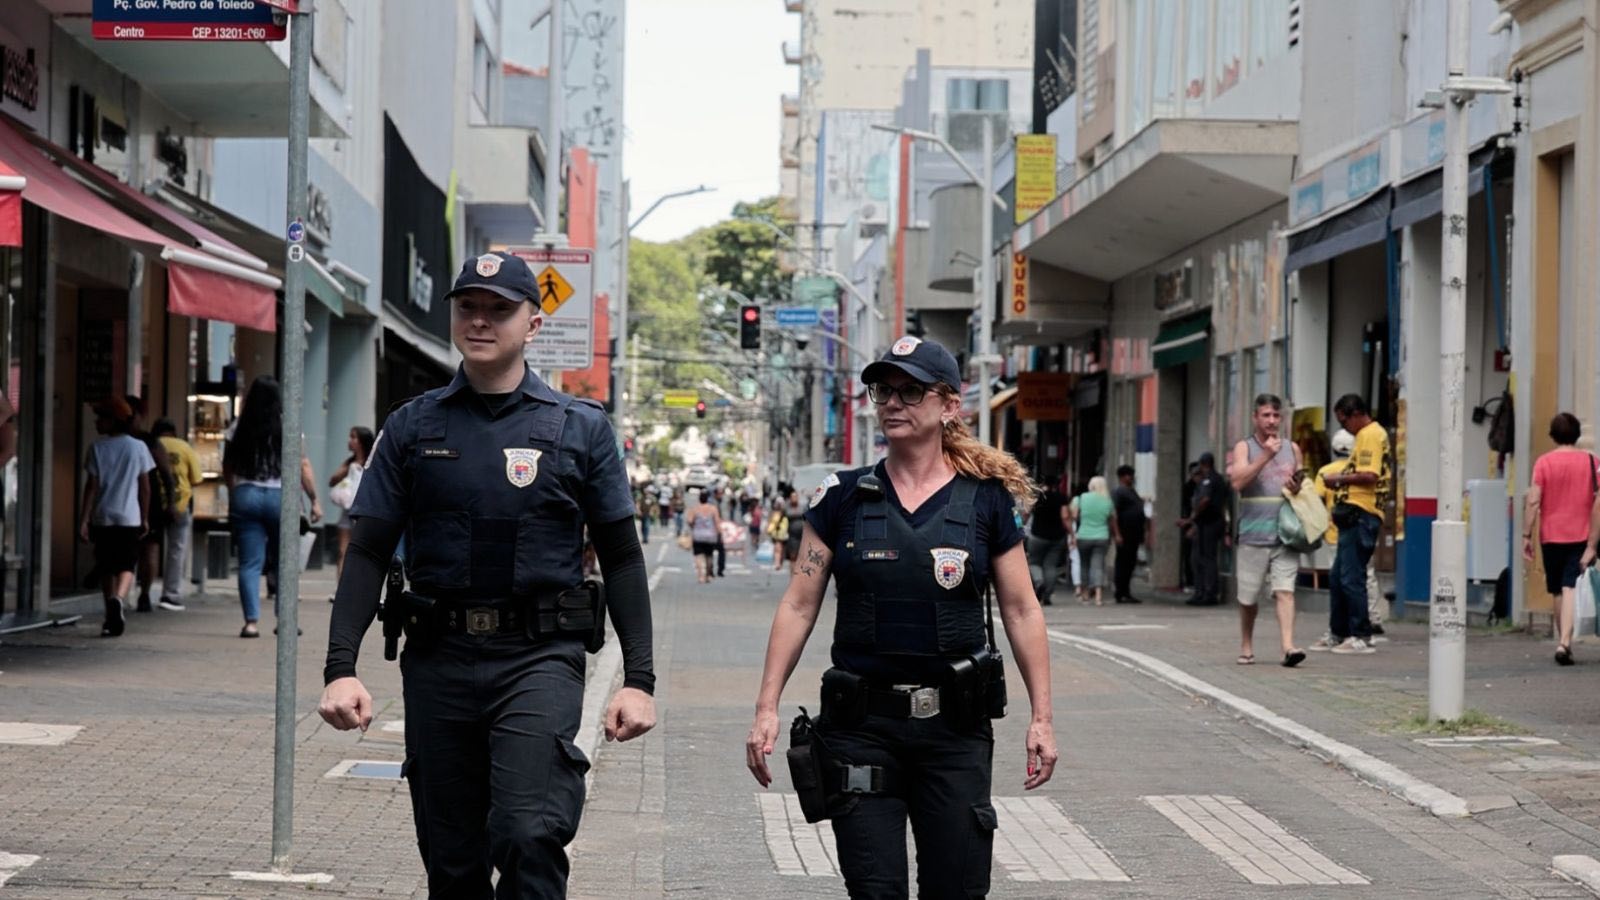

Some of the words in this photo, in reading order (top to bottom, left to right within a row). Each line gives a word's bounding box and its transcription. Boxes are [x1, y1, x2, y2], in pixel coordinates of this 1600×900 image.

[113, 0, 132, 10] Pç.
[136, 0, 160, 9] Gov.
[163, 0, 196, 9] Pedro
[200, 0, 215, 9] de
[218, 0, 255, 9] Toledo
[113, 26, 145, 37] Centro
[192, 27, 212, 39] CEP
[1014, 252, 1026, 314] OURO
